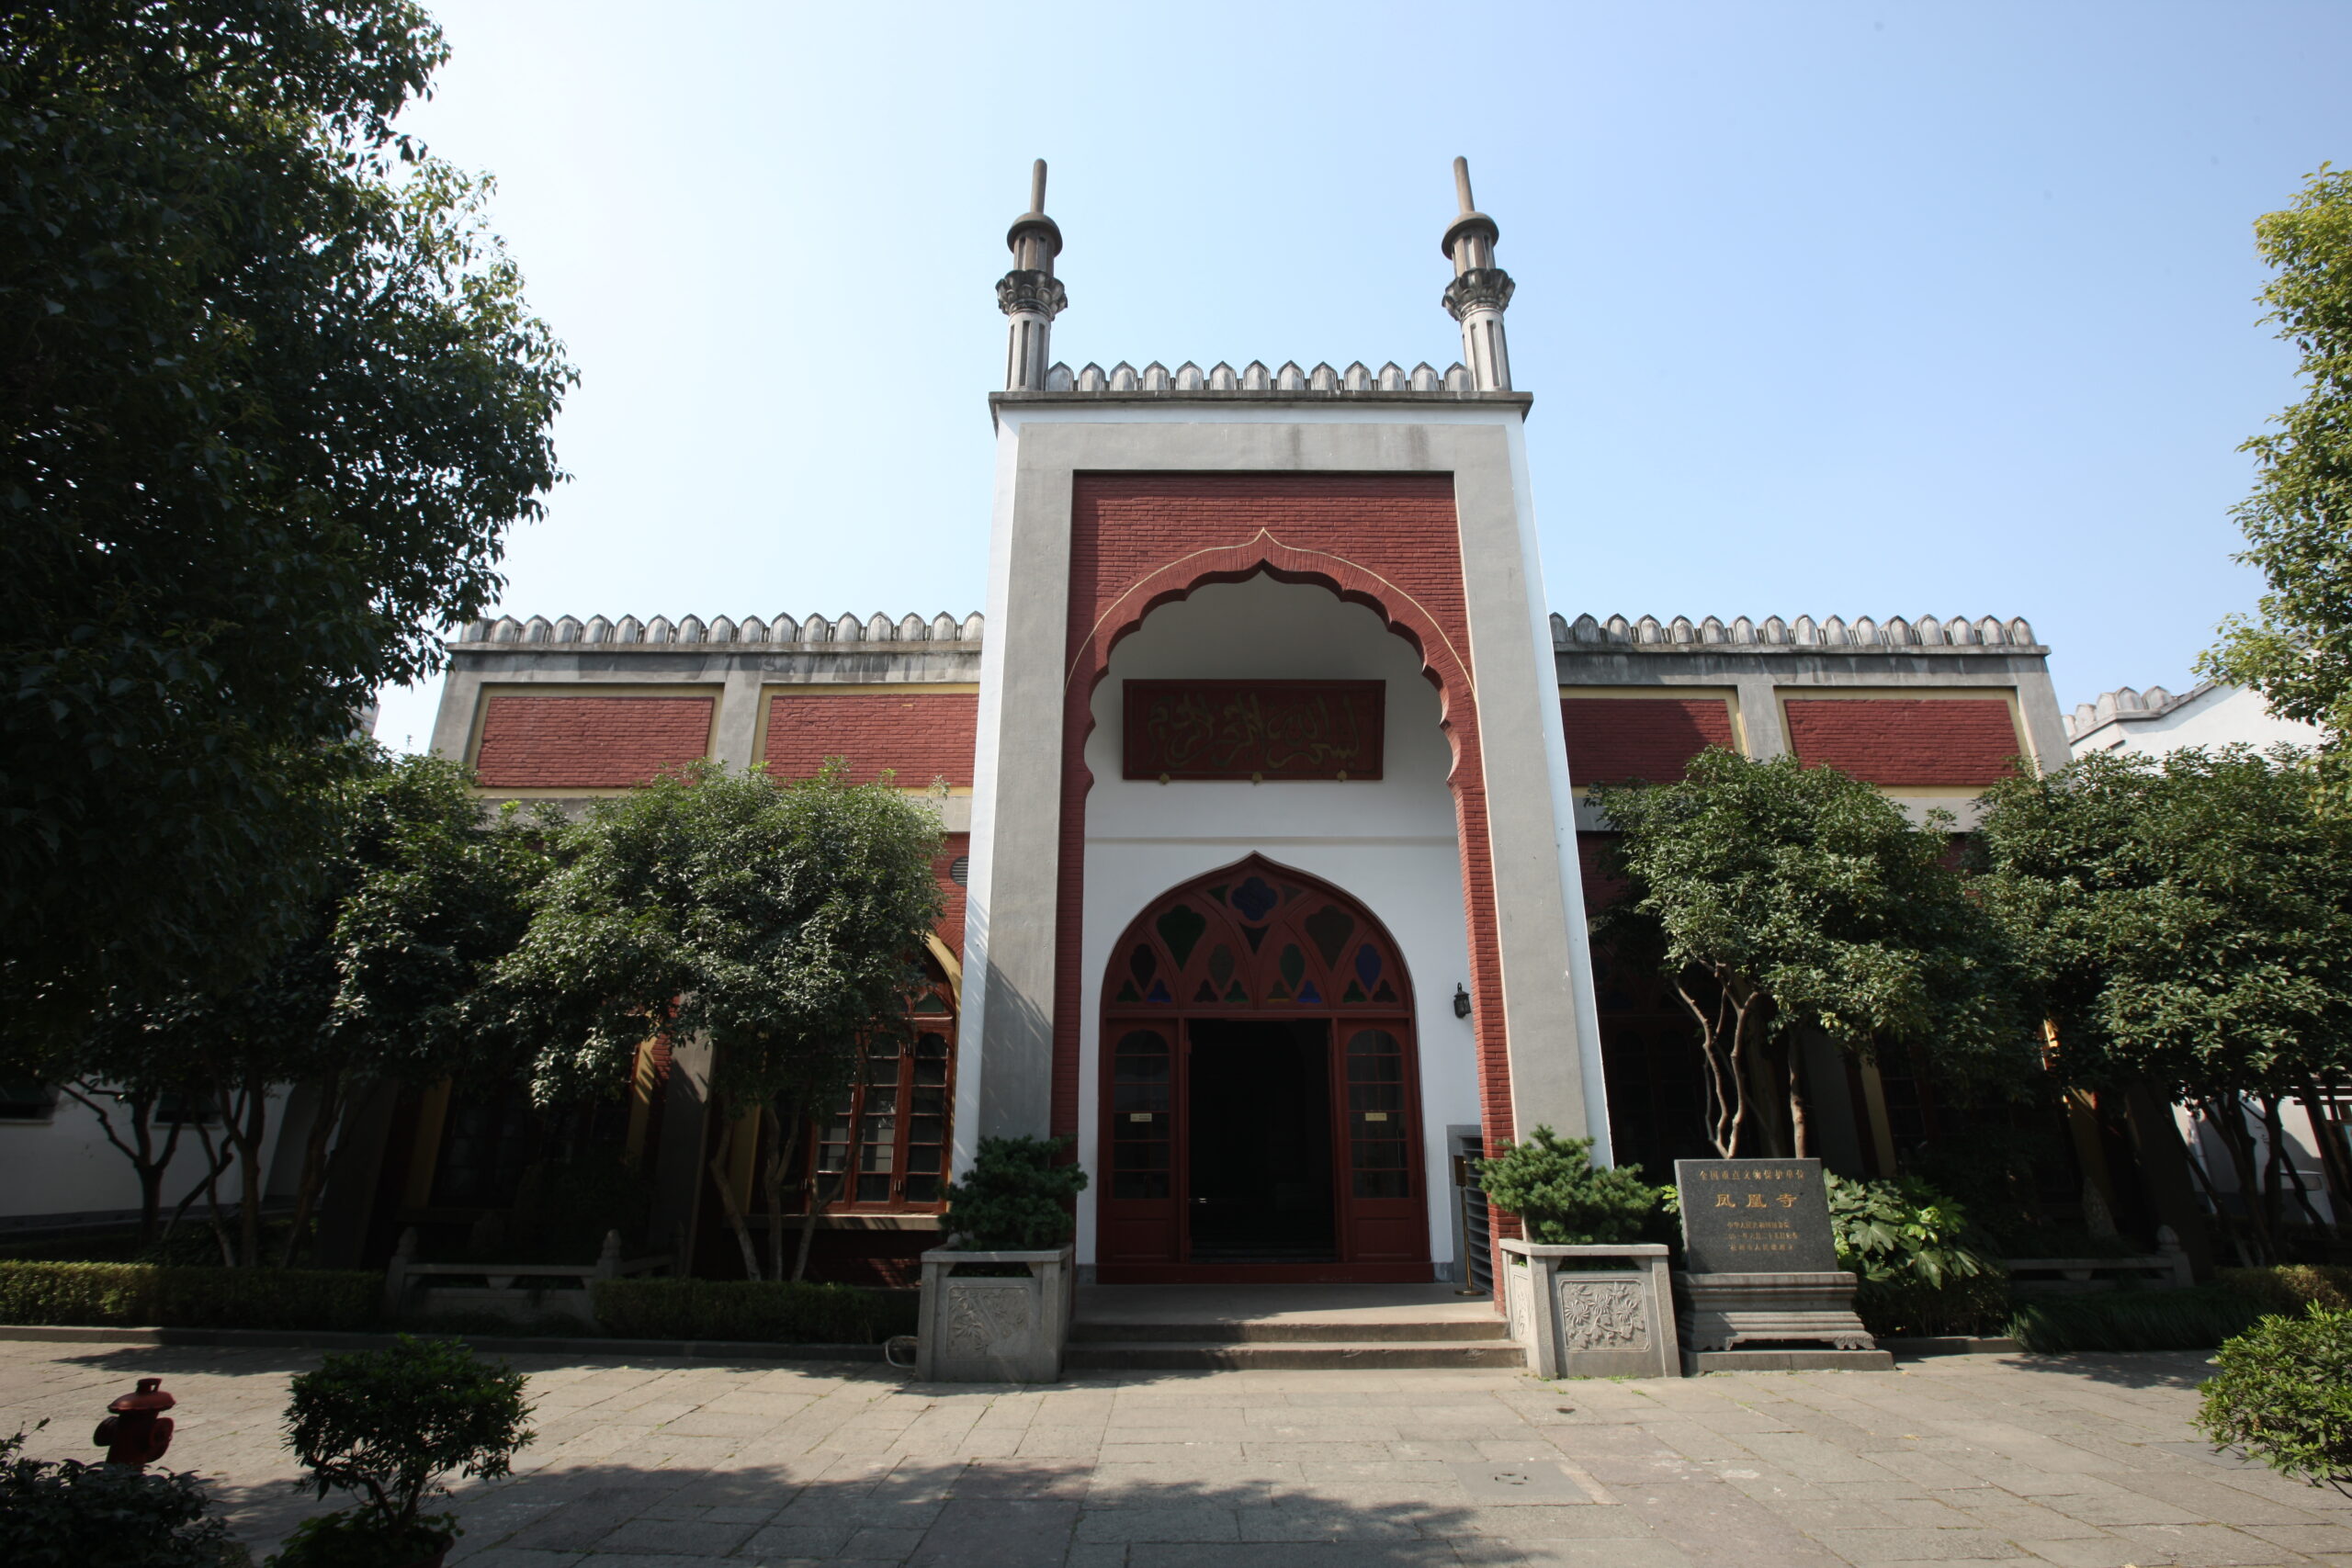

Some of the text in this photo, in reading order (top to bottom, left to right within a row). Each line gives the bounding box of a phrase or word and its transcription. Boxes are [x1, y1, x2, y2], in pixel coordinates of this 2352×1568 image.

[1699, 1169, 1804, 1180] 全国重点文物保护单位
[1714, 1193, 1797, 1208] 凤凰寺
